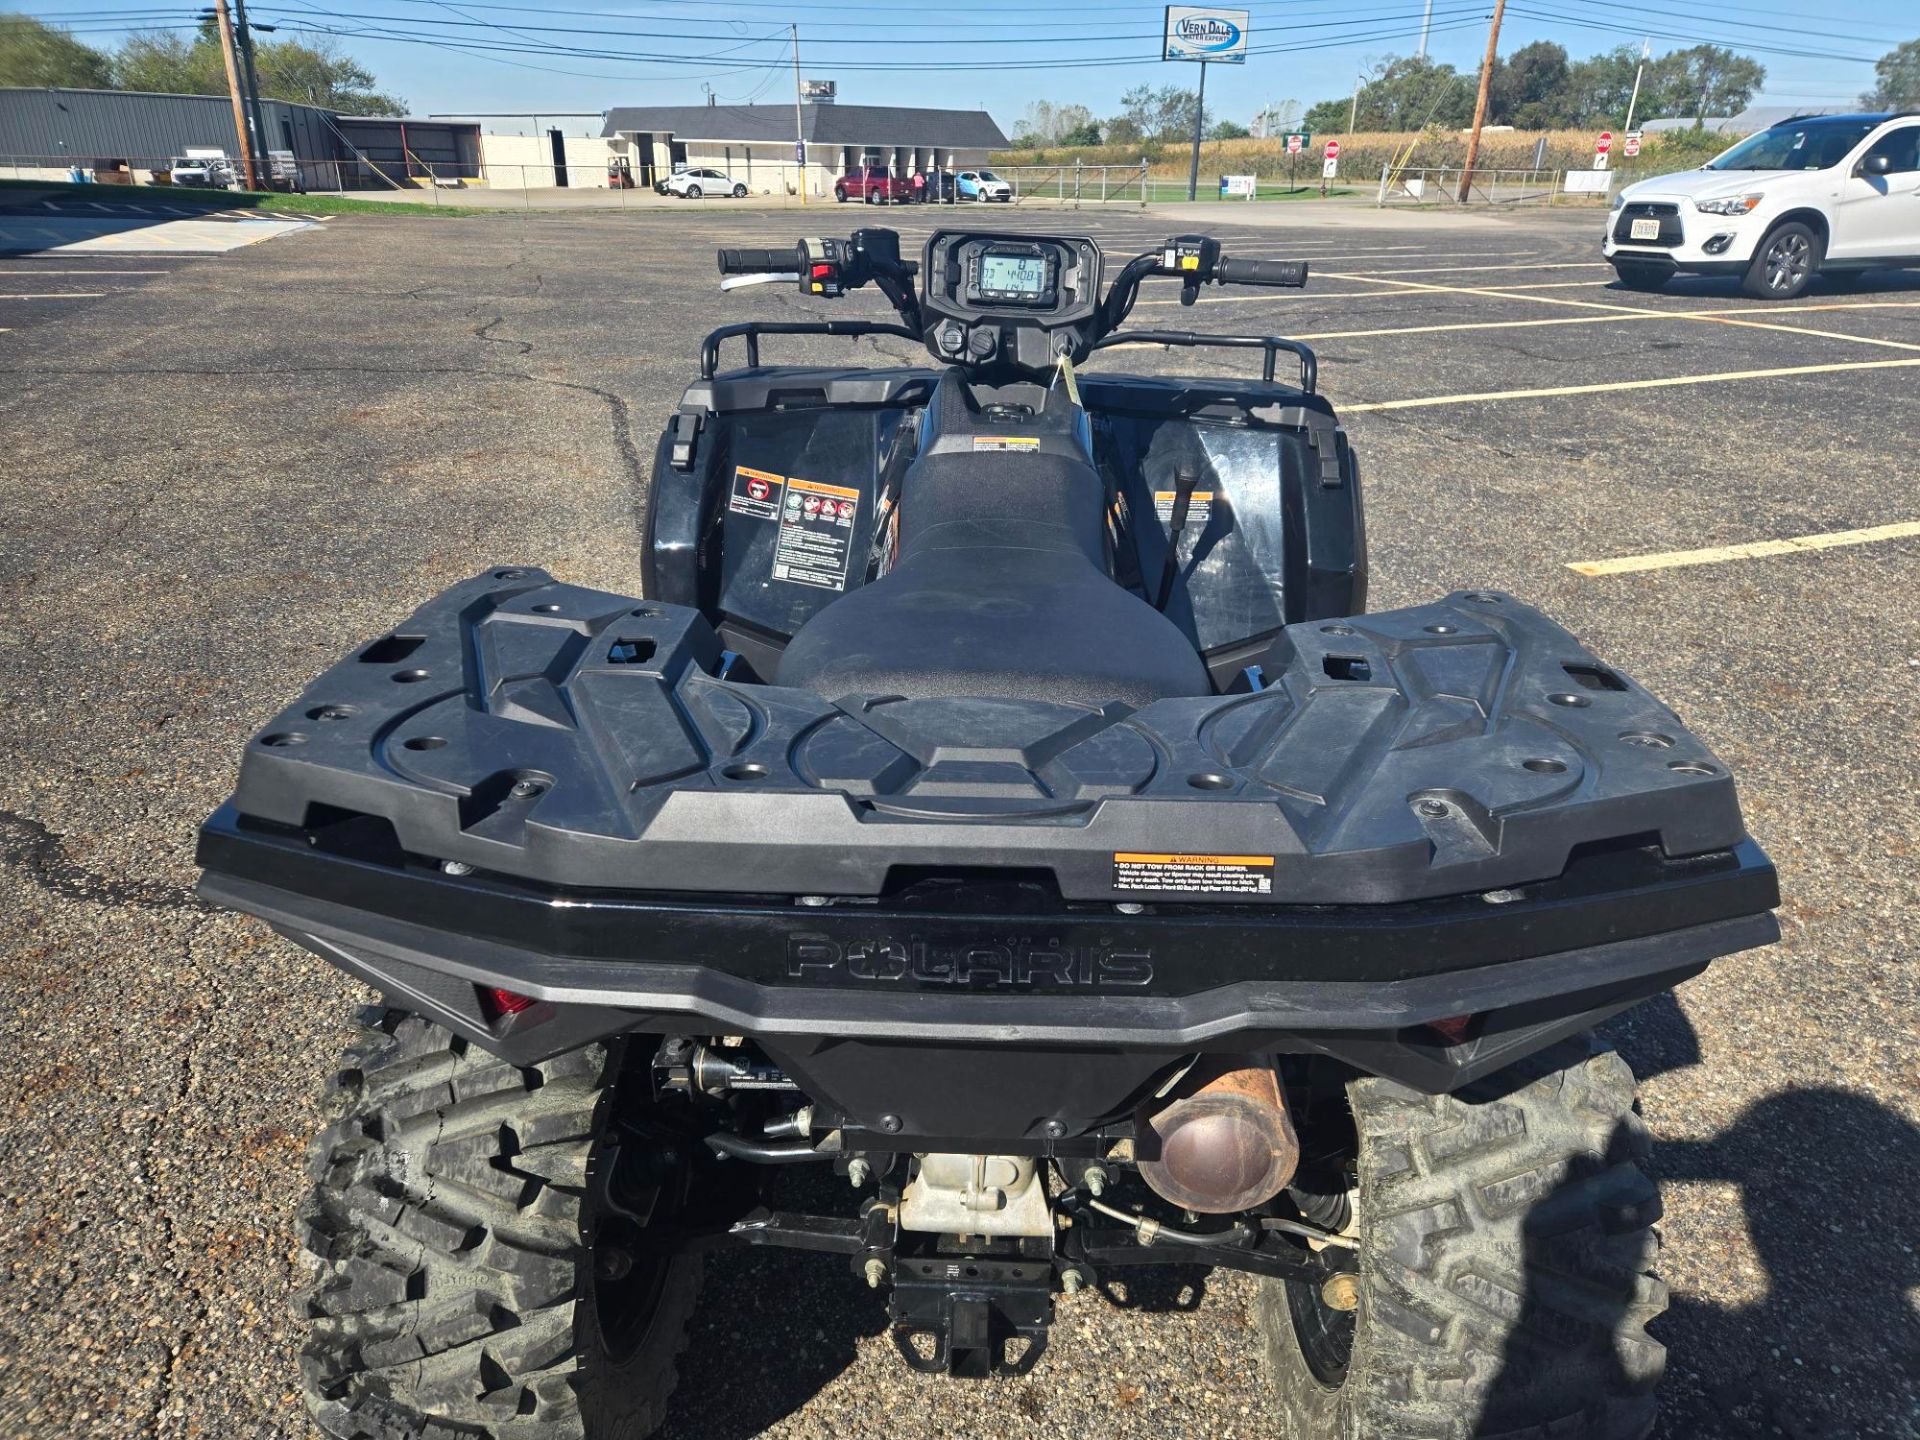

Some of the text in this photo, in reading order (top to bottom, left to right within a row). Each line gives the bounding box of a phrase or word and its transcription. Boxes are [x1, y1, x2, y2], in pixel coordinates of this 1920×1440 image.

[1182, 19, 1206, 34] VERN
[1598, 139, 1611, 147] STOP
[787, 935, 1154, 986] POLARIS
